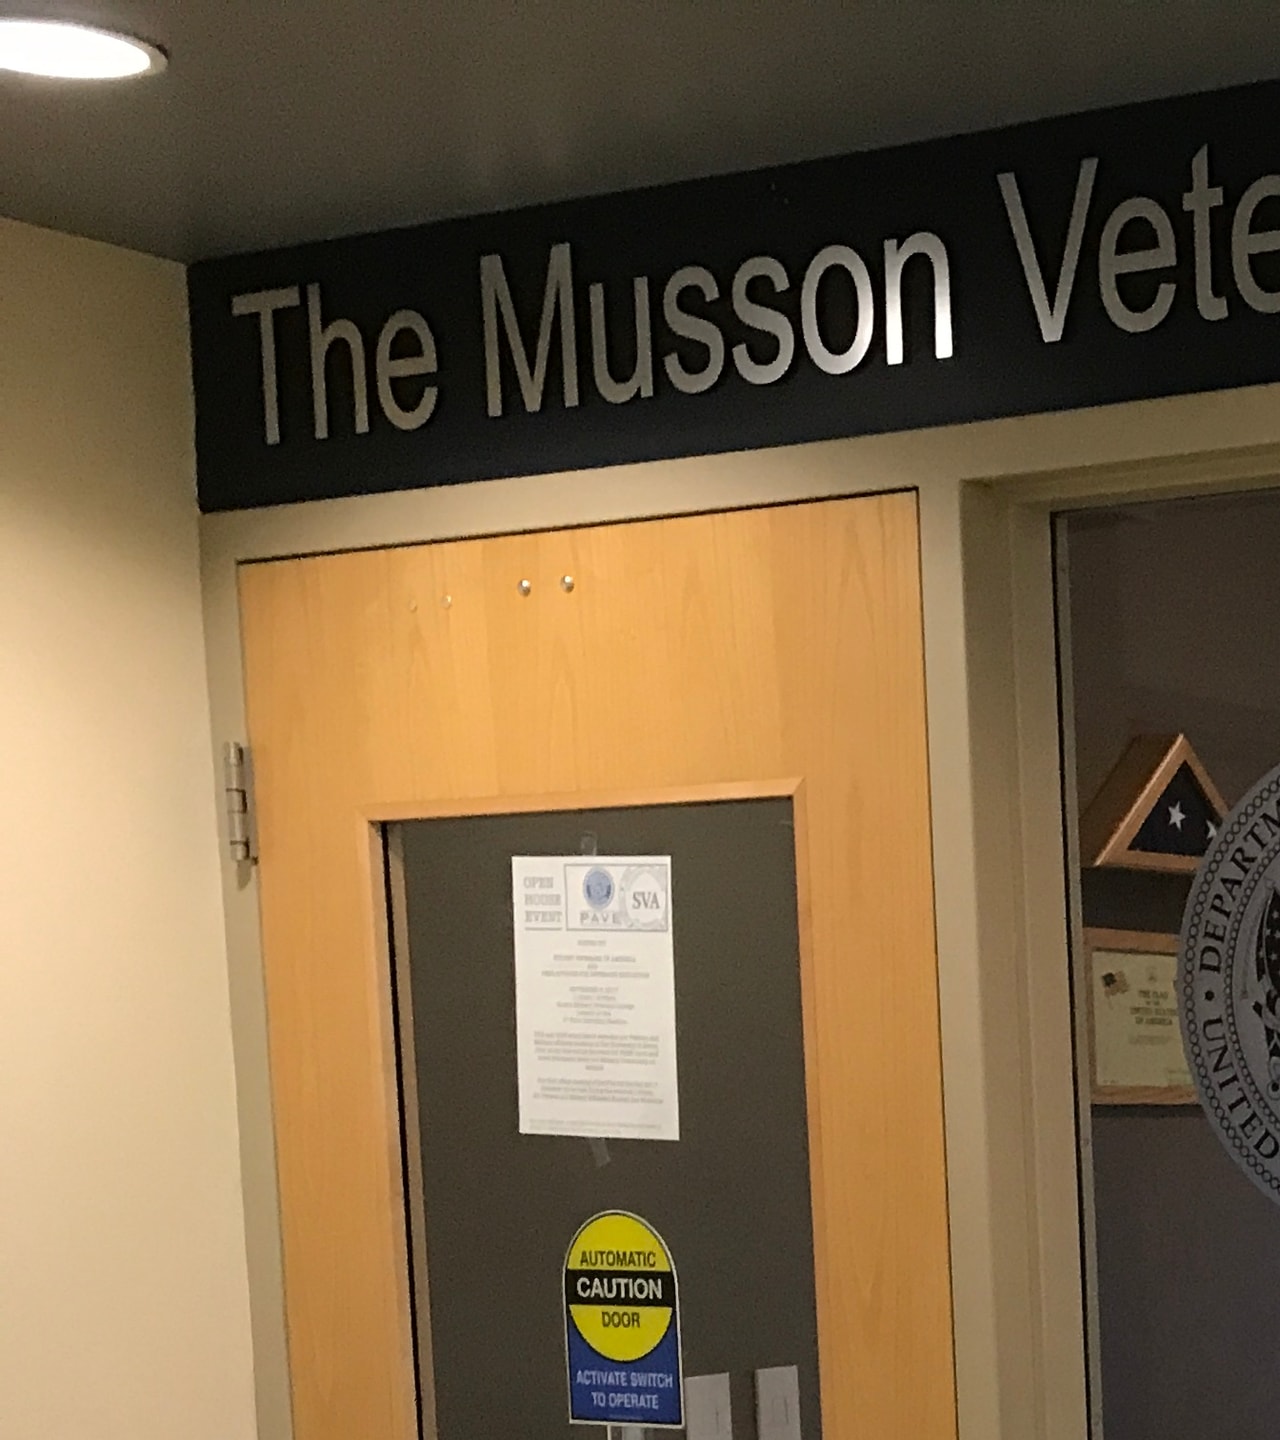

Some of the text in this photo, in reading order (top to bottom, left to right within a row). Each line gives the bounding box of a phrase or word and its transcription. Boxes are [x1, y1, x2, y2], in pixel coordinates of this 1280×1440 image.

[232, 283, 438, 446] The
[480, 230, 954, 417] Musson
[632, 891, 660, 909] SVA
[1202, 1018, 1280, 1161] UNITED
[580, 1250, 656, 1268] AUTOMATIC
[577, 1277, 662, 1300] CAUTION
[602, 1312, 640, 1328] DOOR
[576, 1370, 673, 1388] ACTIVATE SWITCH
[591, 1391, 659, 1410] TO OPERATE
